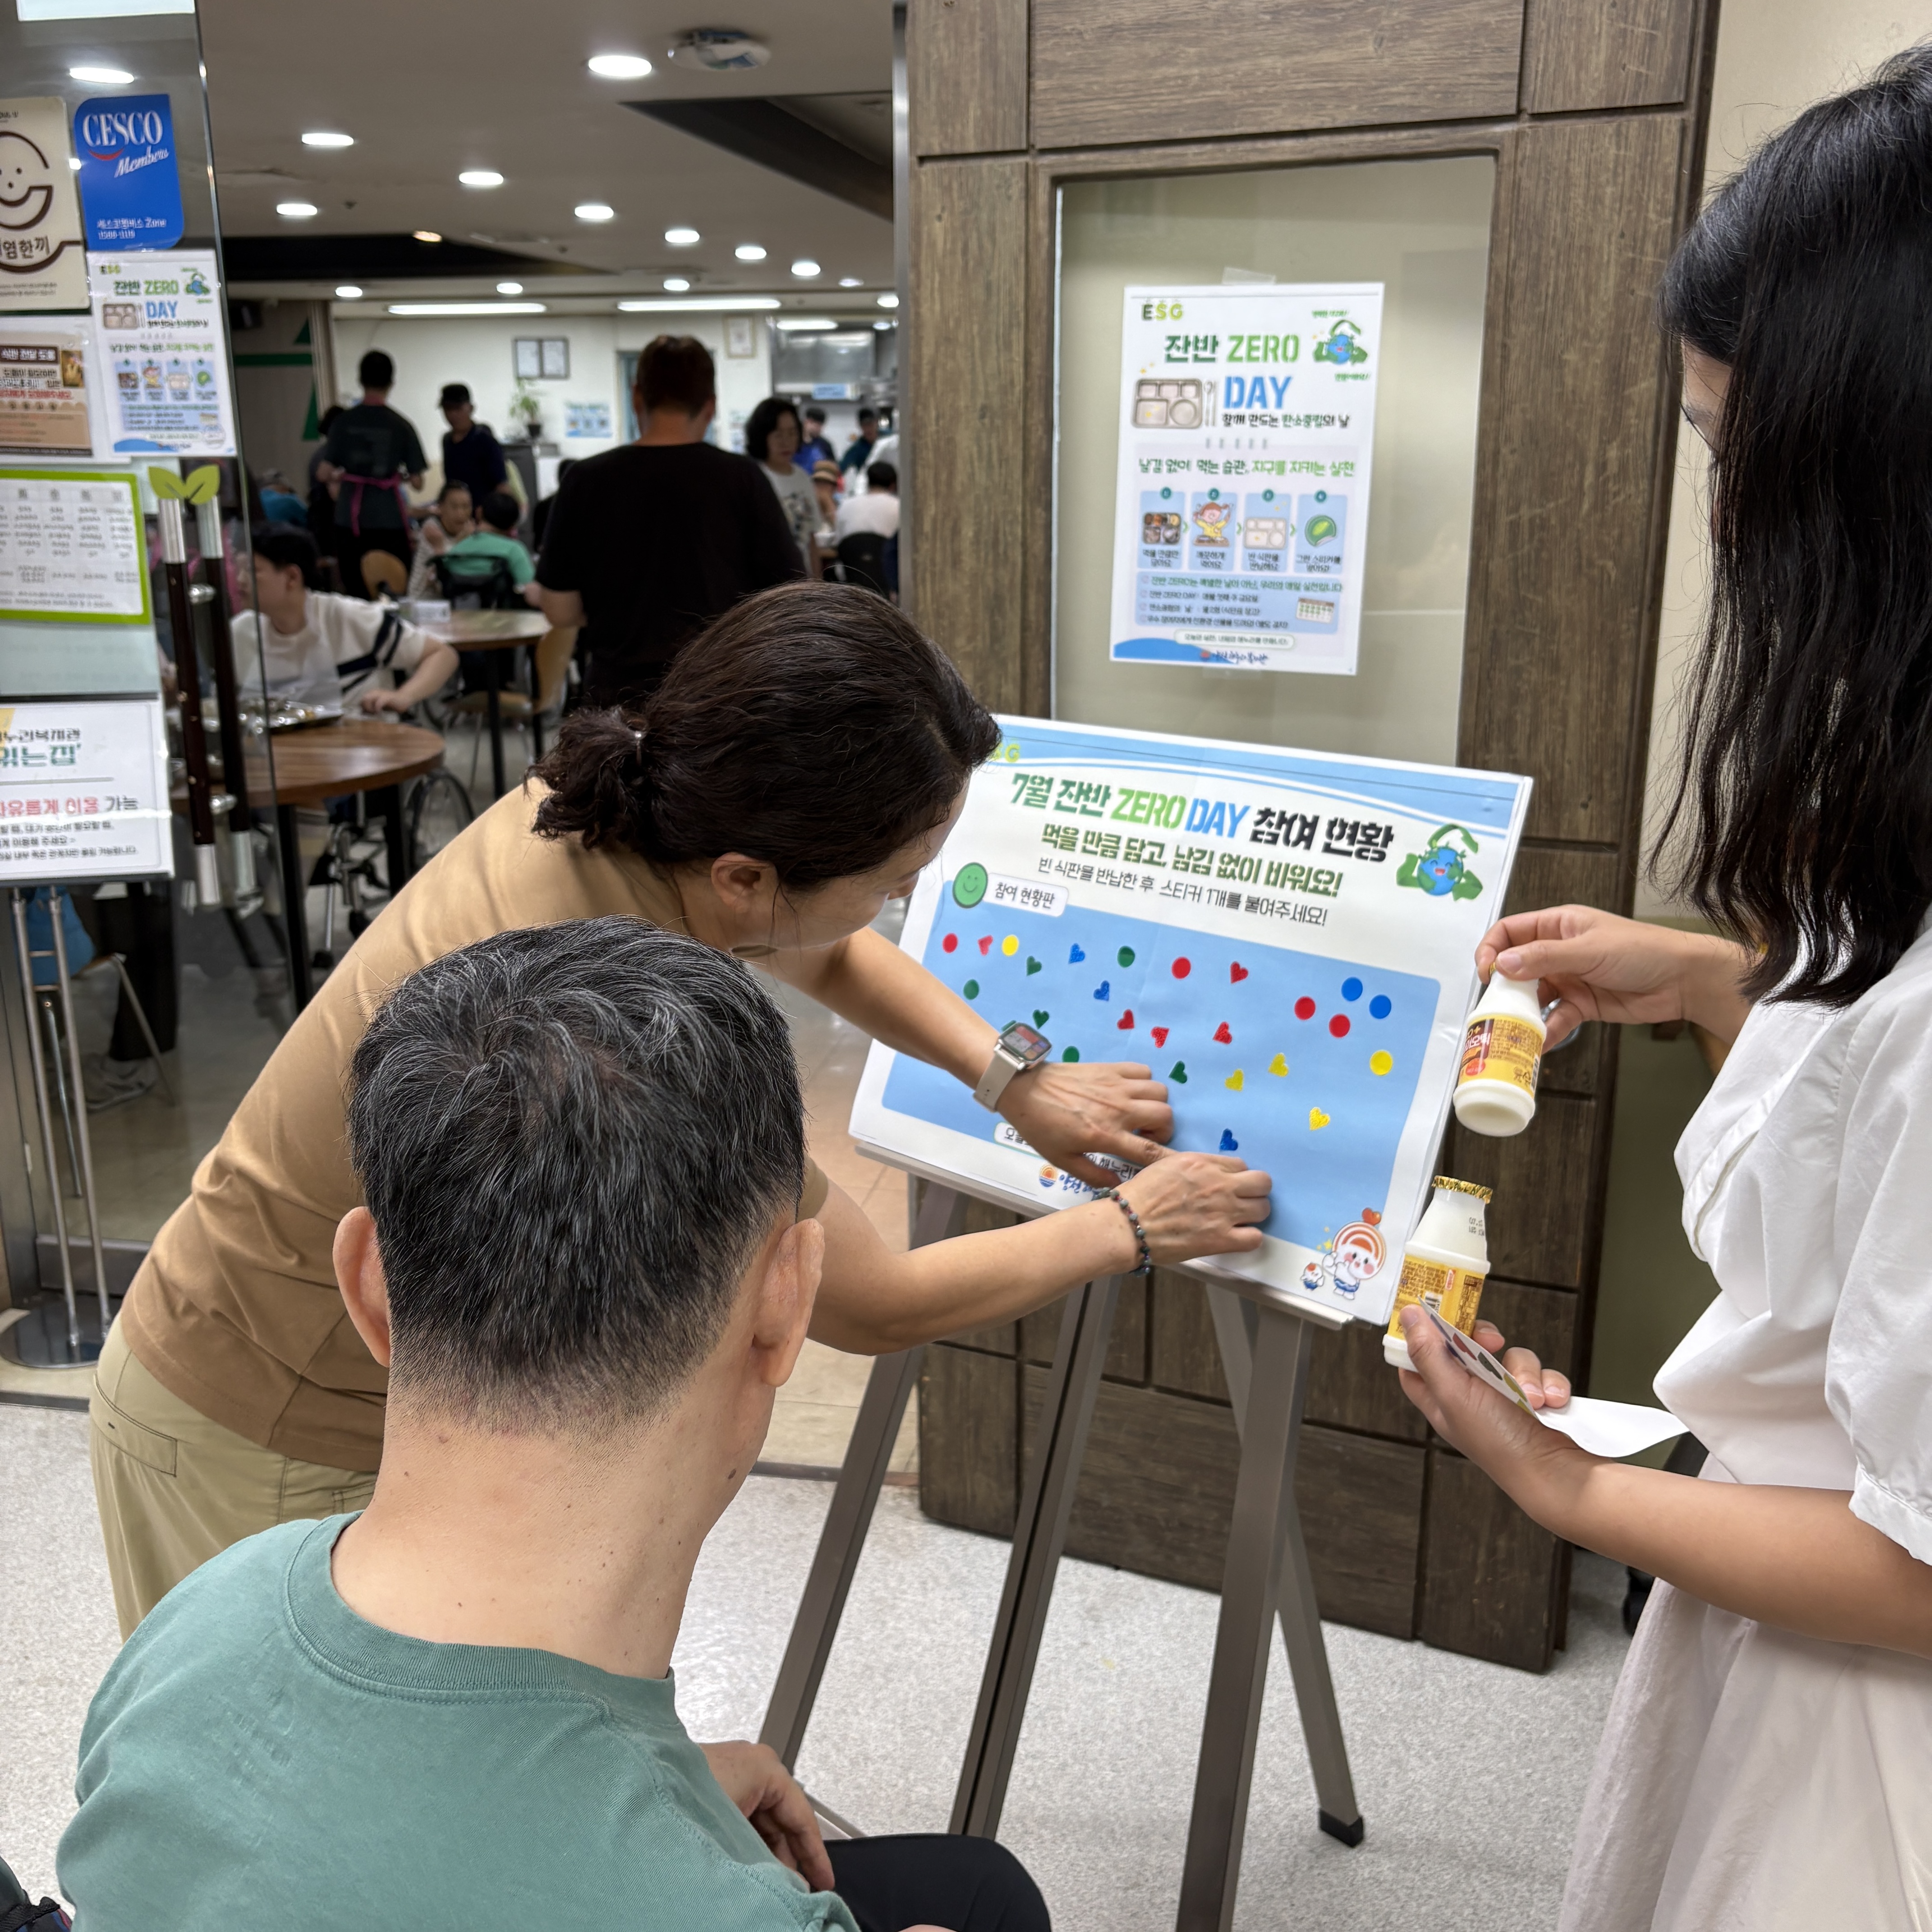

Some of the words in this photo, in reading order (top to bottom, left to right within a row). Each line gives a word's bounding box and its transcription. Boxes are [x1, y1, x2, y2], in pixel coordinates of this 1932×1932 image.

[83, 110, 163, 147] CESCO
[114, 145, 169, 178] Members
[144, 280, 179, 294] ZERO
[146, 300, 178, 318] DAY
[1141, 303, 1183, 321] ESG
[1164, 335, 1219, 363] 잔반
[1227, 335, 1300, 363] ZERO
[1224, 377, 1293, 409] DAY
[1223, 414, 1245, 428] 함께
[1248, 414, 1279, 428] 만드는
[1338, 414, 1349, 428] 날
[1139, 459, 1162, 473] 남김
[1165, 459, 1190, 474] 없이
[1196, 459, 1219, 474] 먹는
[1252, 460, 1285, 476] 지구를
[1289, 460, 1325, 476] 지키는
[65, 796, 99, 814] 이용
[104, 795, 138, 812] 가능
[1011, 773, 1054, 809] 7월
[1053, 779, 1111, 818] 잔반
[1110, 787, 1187, 830] ZERO
[1184, 797, 1251, 839] DAY
[1249, 806, 1320, 851] 참여
[1321, 815, 1395, 863] 현황
[1041, 823, 1079, 854] 먹을
[1082, 830, 1122, 860] 만큼
[1123, 836, 1167, 868] 담고,
[1172, 844, 1214, 877] 남김
[1216, 851, 1263, 885] 없이
[1265, 860, 1343, 898] 비워요!
[994, 881, 1018, 901] 참여
[1020, 886, 1056, 910] 현황판
[1038, 857, 1053, 873] 빈
[1053, 861, 1095, 882] 식판을
[1096, 869, 1137, 889] 반납한
[1139, 875, 1155, 892] 후
[1159, 878, 1202, 901] 스티커
[1206, 886, 1242, 911] 1개를
[1243, 893, 1328, 927] 붙여주세요!
